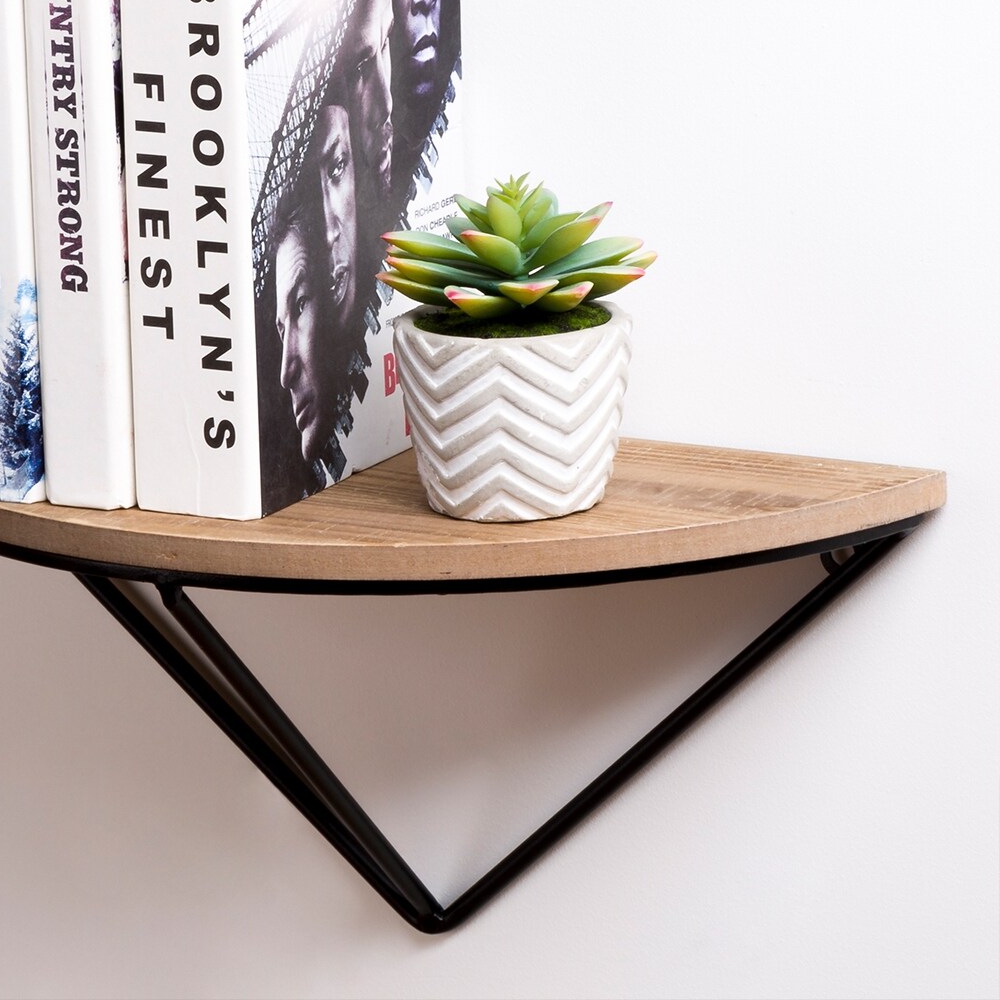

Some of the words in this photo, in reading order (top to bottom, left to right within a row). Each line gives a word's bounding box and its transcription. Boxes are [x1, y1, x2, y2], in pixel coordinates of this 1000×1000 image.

[54, 127, 89, 293] STRONG
[133, 72, 174, 340] FINEST
[414, 201, 440, 219] RICHARD
